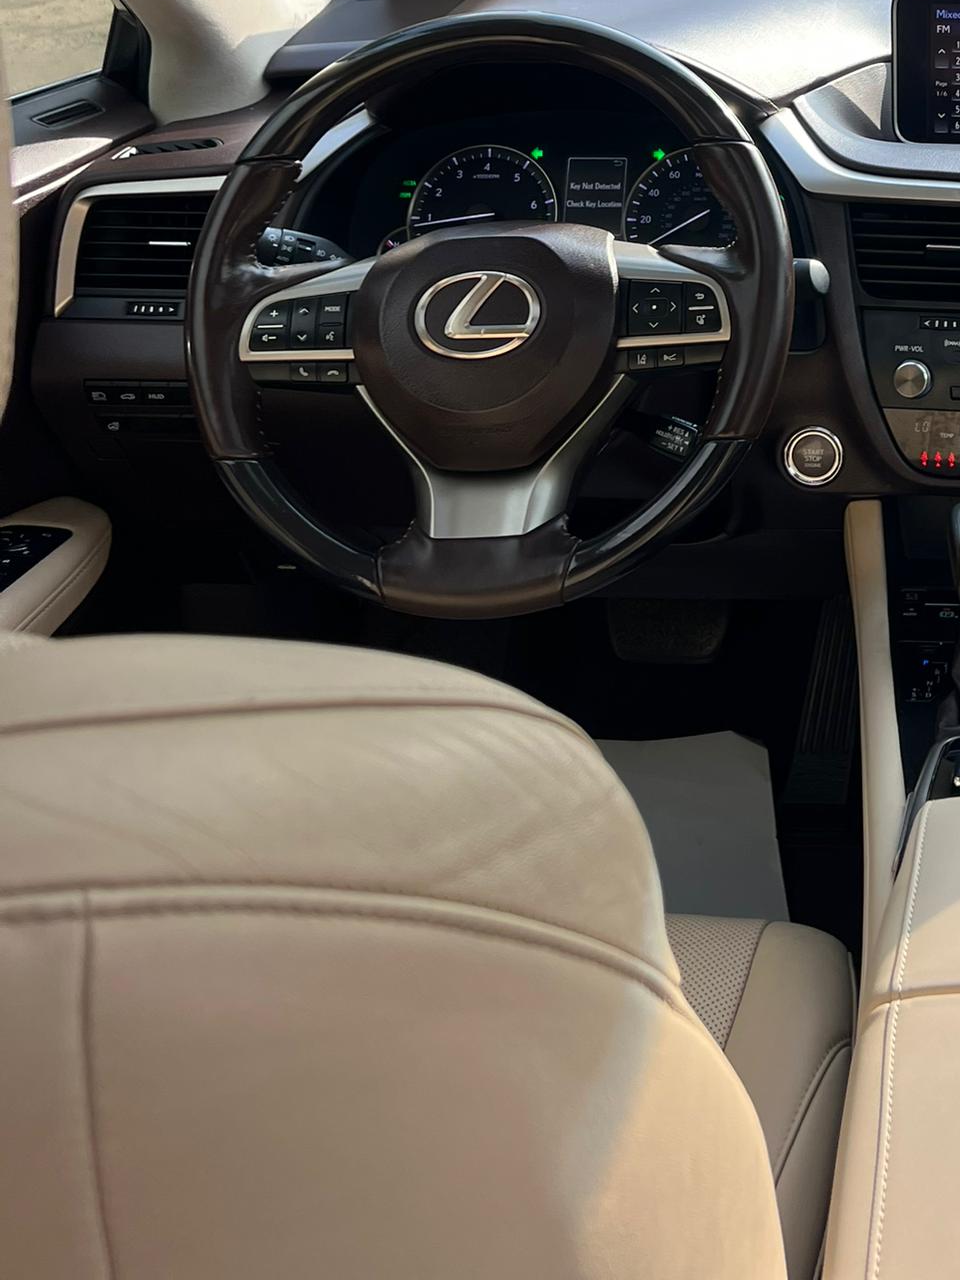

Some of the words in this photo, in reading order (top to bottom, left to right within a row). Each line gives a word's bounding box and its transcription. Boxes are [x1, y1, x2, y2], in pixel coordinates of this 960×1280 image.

[936, 25, 950, 34] FM
[956, 41, 960, 49] 1
[955, 57, 960, 66] 2
[955, 73, 960, 82] 3
[955, 90, 960, 98] 4
[955, 105, 960, 114] 5
[955, 122, 960, 130] 6
[484, 162, 491, 171] 4
[456, 170, 463, 179] 3
[513, 173, 521, 182] 5
[668, 170, 681, 179] 60
[436, 188, 443, 197] 2
[648, 189, 660, 197] 40
[530, 200, 538, 209] 6
[640, 215, 652, 224] 20
